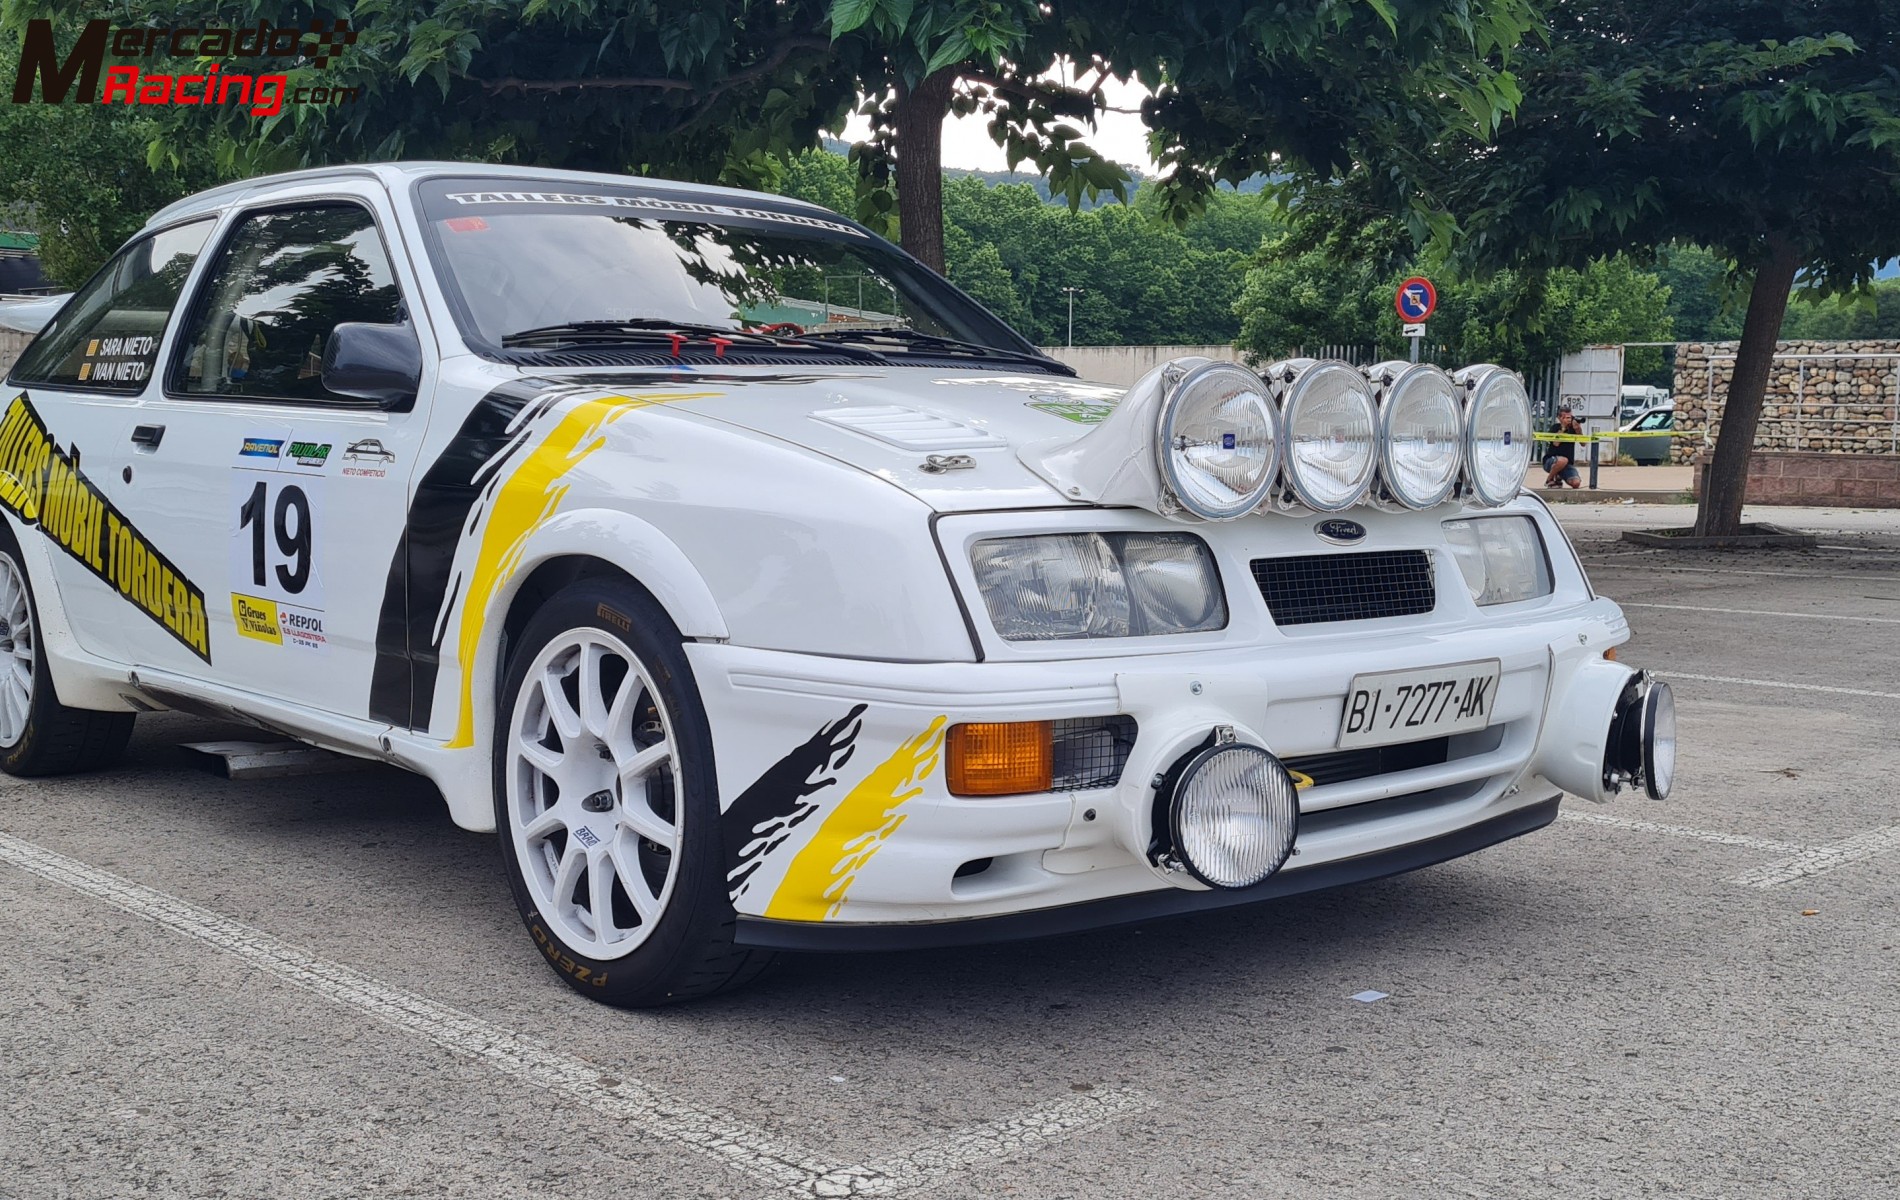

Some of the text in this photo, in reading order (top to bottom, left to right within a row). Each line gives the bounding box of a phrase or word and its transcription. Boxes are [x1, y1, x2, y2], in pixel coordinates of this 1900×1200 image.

[453, 193, 607, 206] TALLERS
[727, 207, 865, 237] TORDERA
[100, 336, 153, 356] SARA NIETO
[92, 361, 145, 381] IVAN NIETO
[243, 442, 279, 454] RAVENOL
[240, 481, 312, 595] 19
[1330, 521, 1359, 536] Ford
[108, 511, 208, 657] TORDERA
[247, 606, 267, 621] Grues
[289, 613, 323, 633] REPSOL
